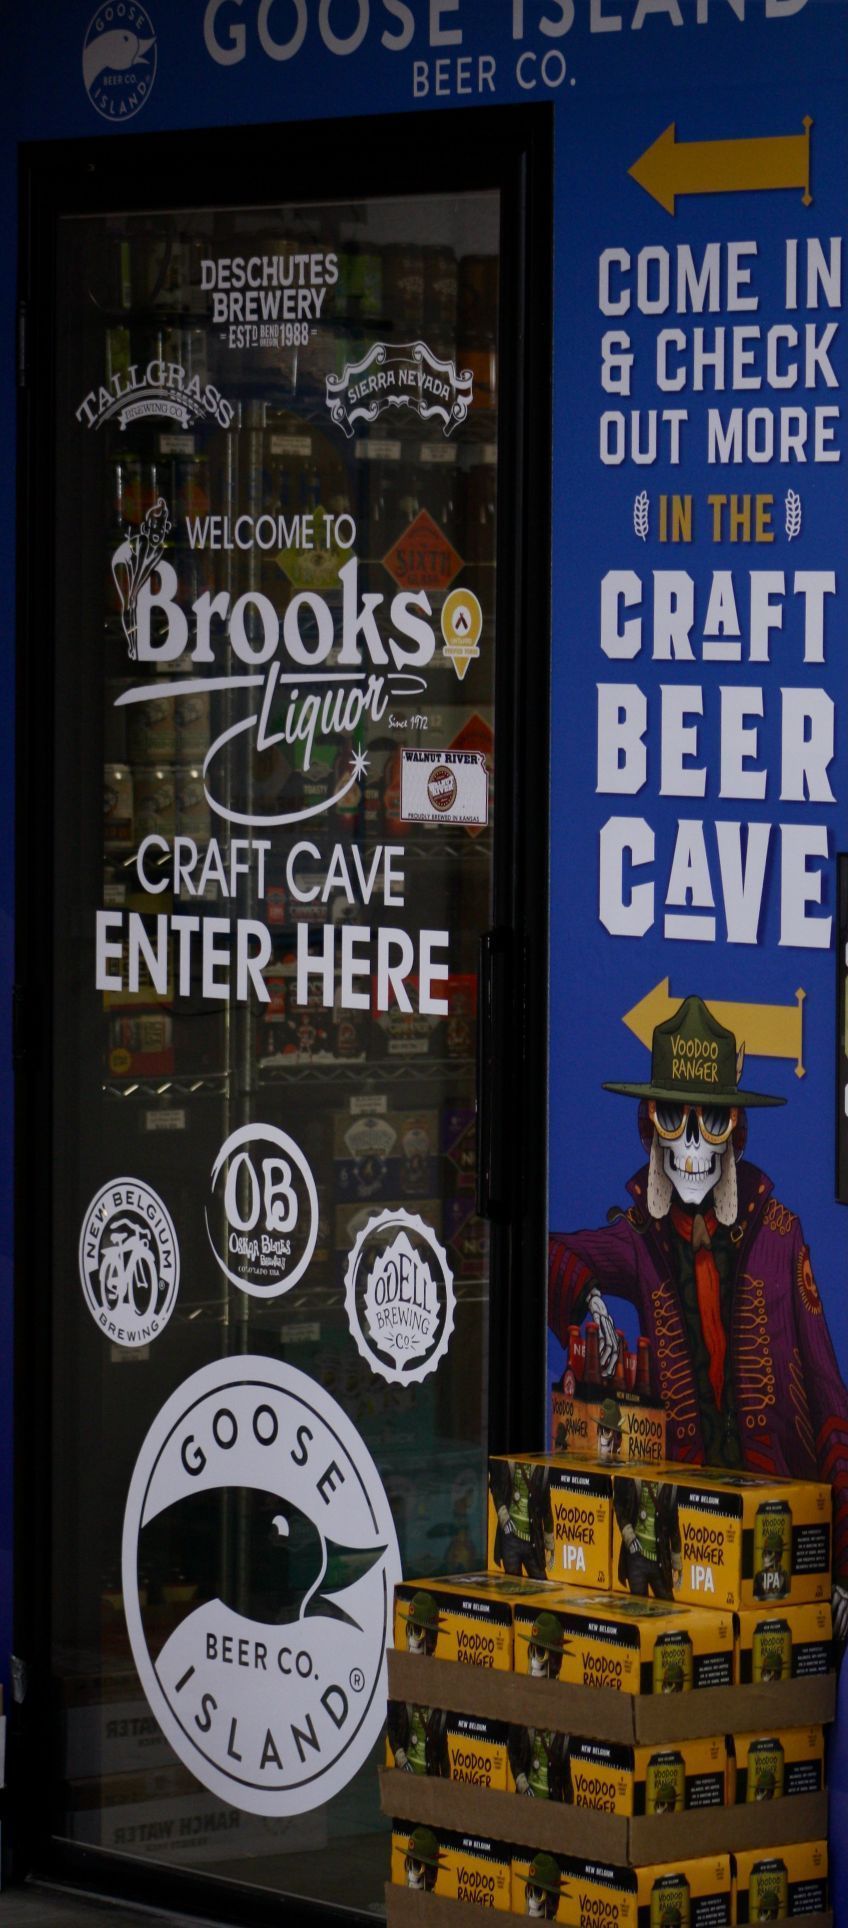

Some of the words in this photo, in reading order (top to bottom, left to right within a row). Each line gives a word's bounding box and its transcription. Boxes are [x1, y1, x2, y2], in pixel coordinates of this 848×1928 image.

[96, 6, 145, 31] GOOSE
[104, 75, 123, 86] BEER
[412, 55, 497, 97] BEER
[515, 49, 576, 90] CO.
[95, 80, 147, 115] ISLAND
[200, 253, 339, 290] DESCHUTES
[598, 240, 758, 316] COME
[785, 236, 842, 309] IN
[212, 287, 327, 323] BREWERY
[260, 324, 279, 338] BEND
[280, 322, 309, 347] 1988
[601, 329, 635, 396] &
[656, 322, 839, 391] CHECK
[75, 360, 235, 429] TALLGRASS
[348, 370, 396, 404] SIERRA
[398, 369, 451, 401] NEVADA
[125, 401, 168, 419] BREWING
[600, 408, 688, 465] OUT
[707, 405, 840, 464] MORE
[186, 513, 314, 550] WELCOME
[322, 513, 356, 549] TO
[659, 494, 692, 542] IN
[707, 494, 776, 542] THE
[134, 555, 436, 671] Brooks
[600, 569, 837, 663] CRAFT
[256, 661, 389, 772] Liquor
[388, 714, 407, 728] Since
[410, 716, 429, 730] 1972
[595, 682, 838, 803] BEER
[405, 752, 441, 763] WALNUT
[445, 754, 478, 764] RIVER
[137, 834, 271, 898] CRAFT
[286, 840, 404, 907] CAVE
[599, 815, 833, 949] CAVE
[95, 909, 272, 1003] ENTER
[297, 922, 449, 1016] HERE
[671, 1034, 718, 1060] VOODOO
[672, 1058, 719, 1083] RANGER
[224, 1152, 298, 1233] OB
[86, 1203, 106, 1258] NEW
[112, 1191, 172, 1269] BELGIUM
[375, 1253, 431, 1314] ODELL
[99, 1312, 160, 1342] BREWING
[376, 1307, 430, 1335] BREWING
[552, 1399, 574, 1416] VOODOO
[566, 1418, 588, 1438] RANGER
[628, 1413, 662, 1439] VOODOO
[181, 1404, 345, 1505] GOOSE
[628, 1437, 662, 1461] RANGER
[555, 1503, 595, 1526] VOODOO
[556, 1523, 595, 1545] RANGER
[682, 1523, 724, 1546] VOODOO
[563, 1544, 586, 1573] IPA
[683, 1542, 724, 1566] RANGER
[691, 1564, 715, 1593] IPA
[763, 1572, 780, 1590] IPA
[456, 1629, 494, 1653] VOODOO
[206, 1633, 268, 1670] BEER
[278, 1647, 319, 1680] CO.
[457, 1650, 494, 1668] RANGER
[581, 1651, 622, 1675] VOODOO
[583, 1672, 622, 1691] RANGER
[174, 1666, 350, 1770] ISLAND
[451, 1749, 491, 1772] VOODOO
[452, 1769, 491, 1788] RANGER
[575, 1773, 616, 1796] VOODOO
[576, 1793, 616, 1813] RANGER
[456, 1867, 495, 1891] VOODOO
[457, 1888, 495, 1908] RANGER
[579, 1895, 619, 1920] VOODOO
